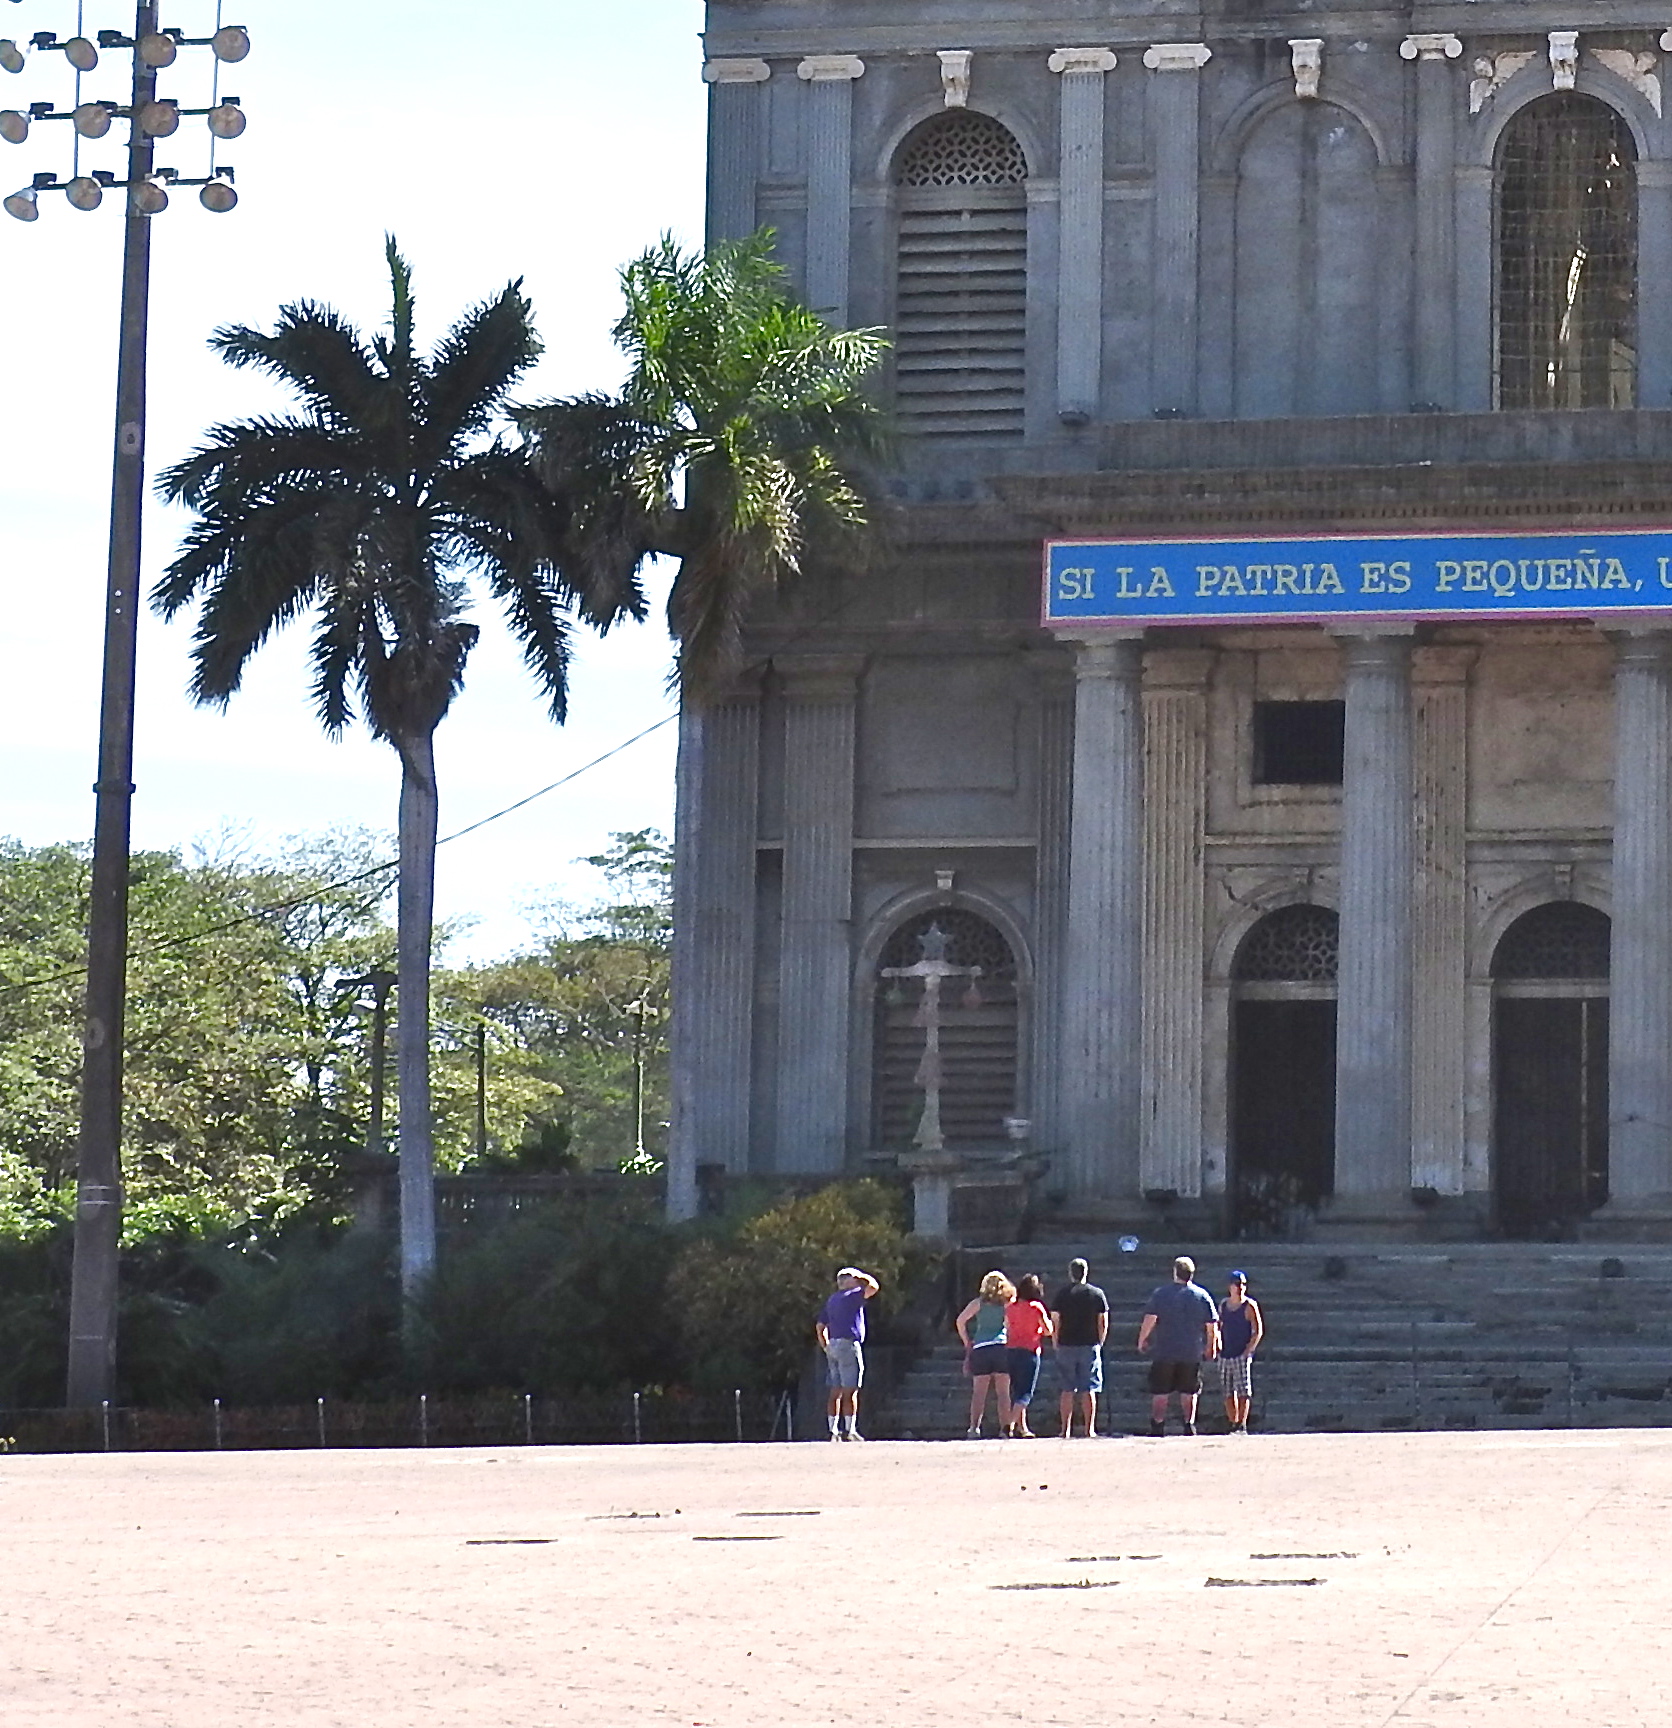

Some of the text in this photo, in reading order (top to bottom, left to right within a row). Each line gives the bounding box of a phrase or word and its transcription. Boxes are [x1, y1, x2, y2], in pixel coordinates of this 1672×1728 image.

[1058, 567, 1096, 600] SI
[1116, 565, 1176, 599] LA
[1194, 563, 1345, 598] PATRIA
[1359, 561, 1412, 595] ES
[1434, 548, 1645, 598] PEQUEÑA,
